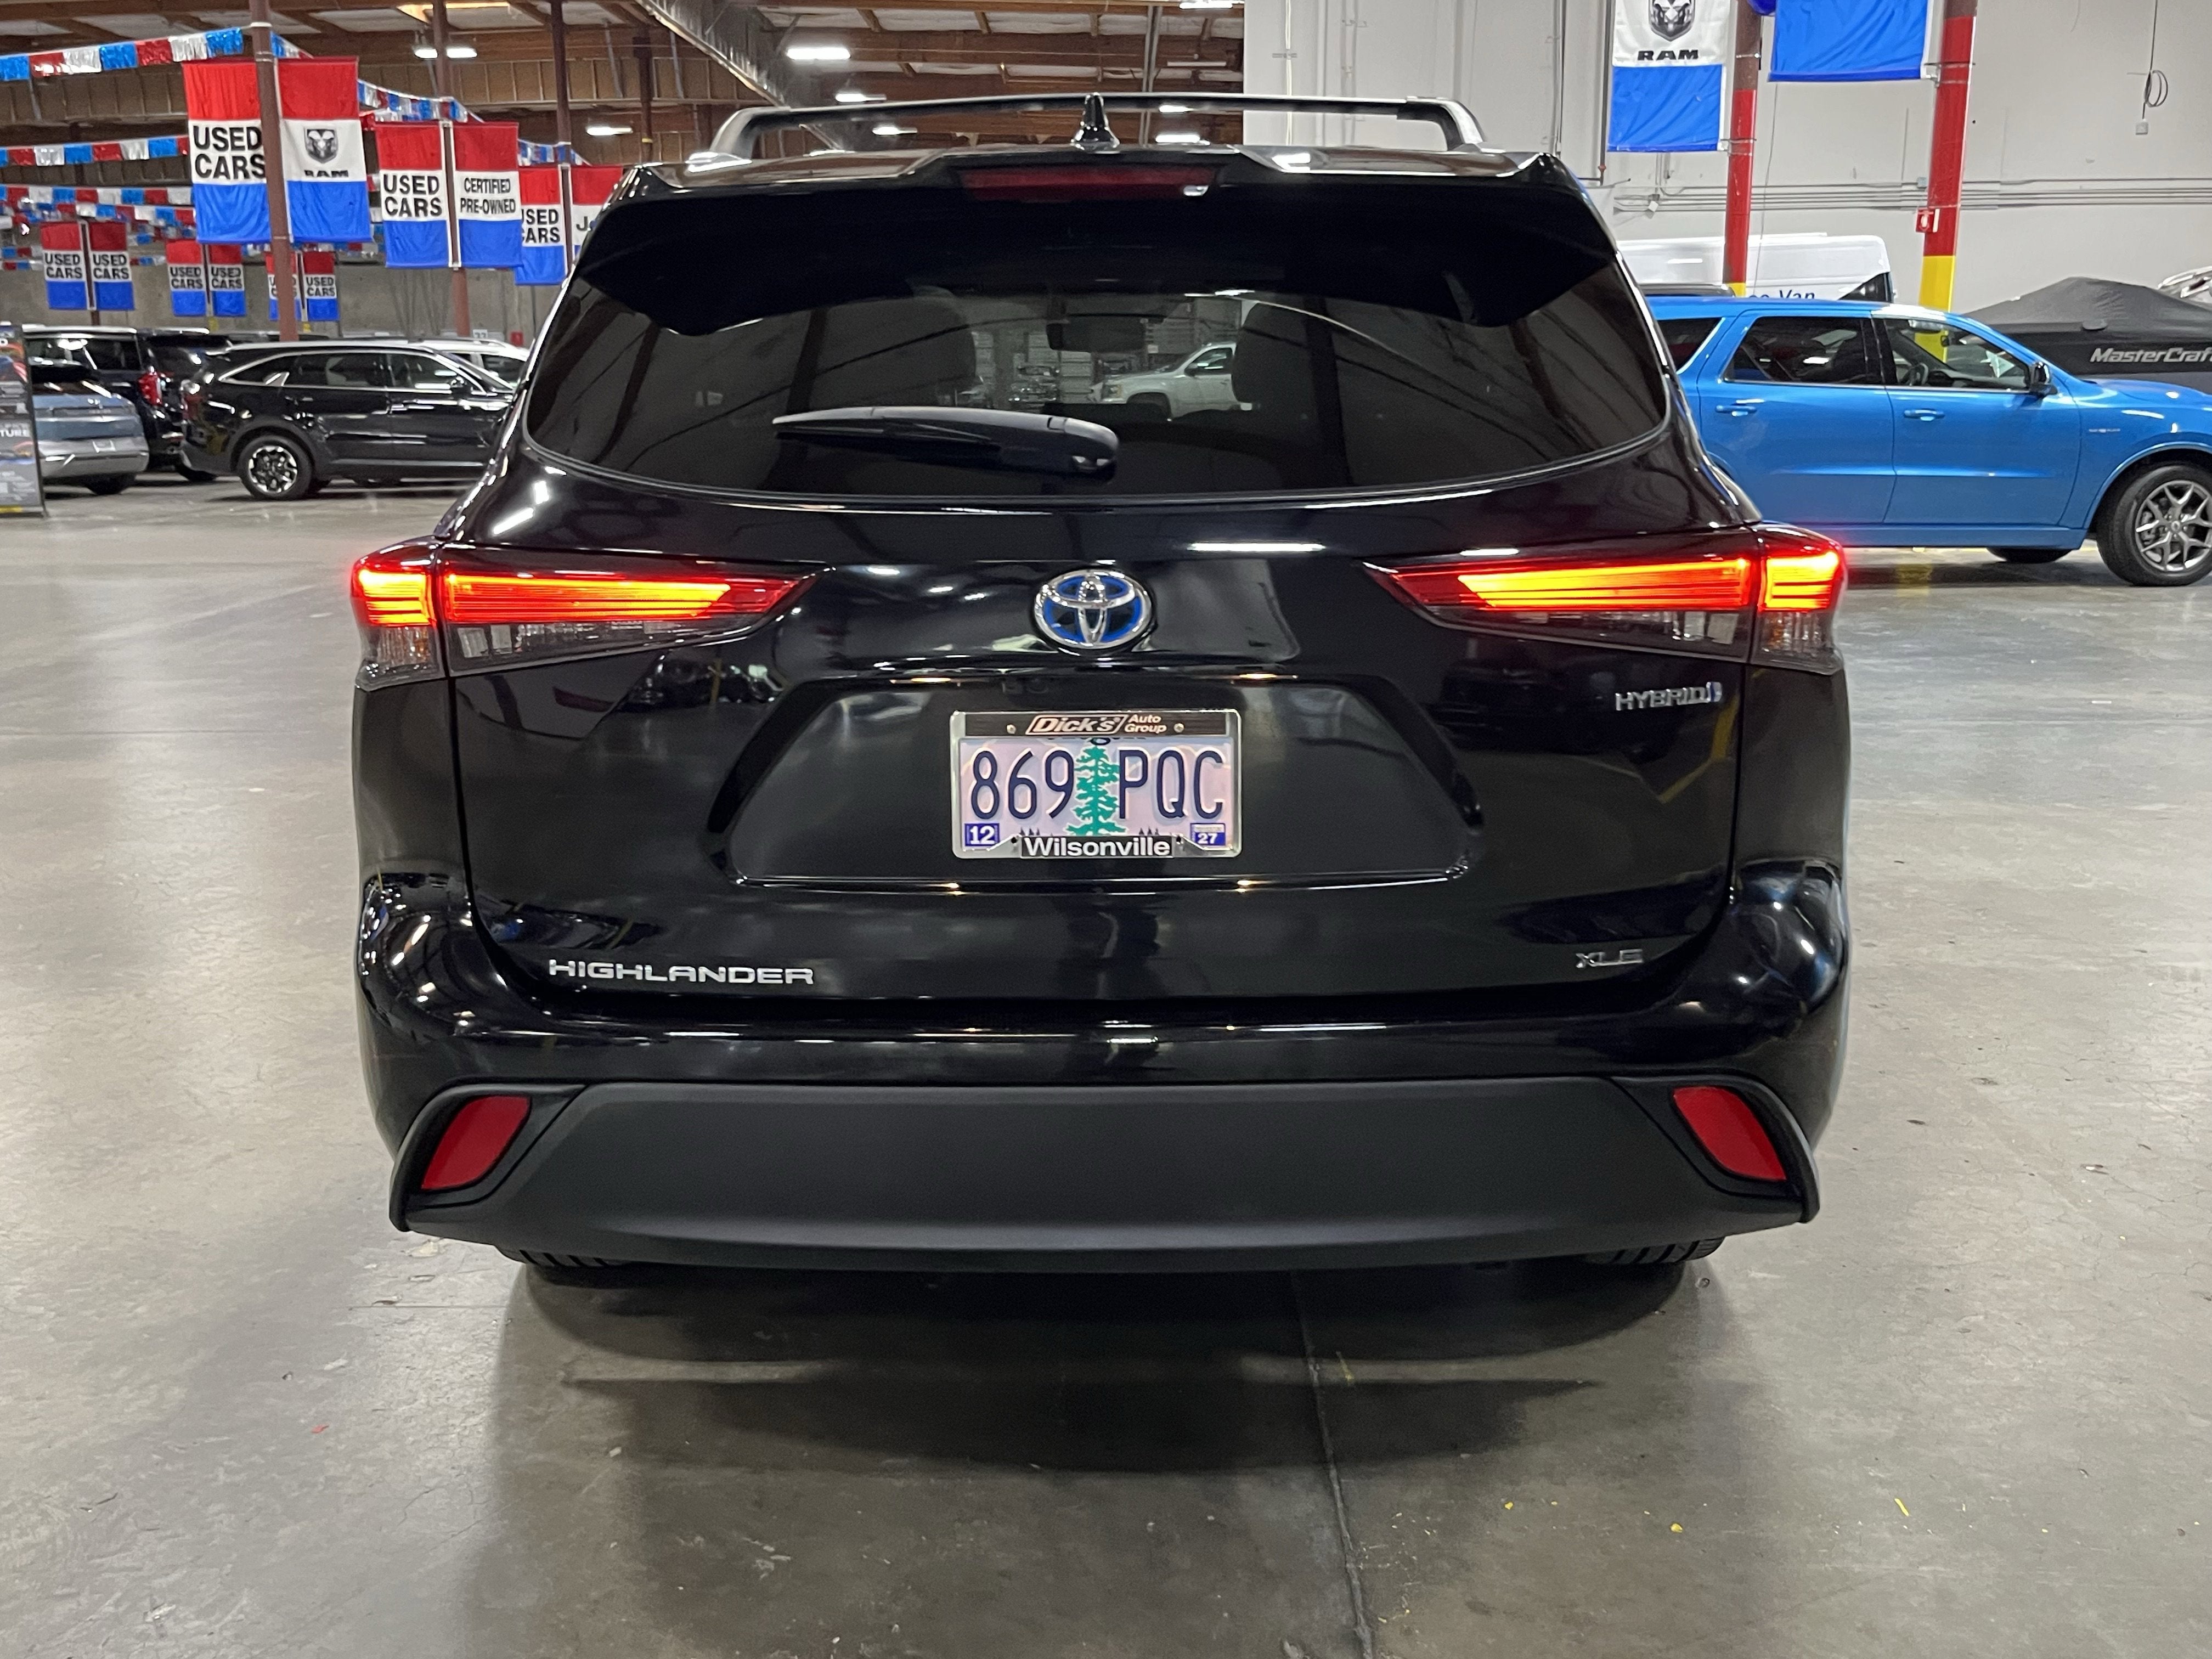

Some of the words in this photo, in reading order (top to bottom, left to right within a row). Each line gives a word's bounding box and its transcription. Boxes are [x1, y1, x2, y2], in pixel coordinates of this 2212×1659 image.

[1637, 49, 1699, 60] RAM
[193, 126, 262, 151] USED
[195, 154, 264, 179] CARS
[304, 170, 349, 178] RAM
[383, 174, 439, 195] USED
[464, 178, 511, 194] CERTIFIED
[385, 197, 442, 217] CARS
[460, 198, 516, 215] PRE-OWNED
[45, 253, 80, 265] USED
[93, 254, 127, 266] USED
[46, 267, 82, 278] CARS
[93, 268, 129, 279] CARS
[170, 267, 201, 276] USED
[211, 267, 241, 277] USED
[171, 278, 202, 289] CARS
[212, 278, 242, 289] CARS
[306, 277, 334, 286] USED
[307, 287, 335, 296] CARS
[2090, 347, 2212, 363] MasterCraf
[1615, 686, 1707, 711] HYBRID
[1032, 717, 1117, 732] Dick's
[1128, 714, 1161, 724] Auto
[1125, 724, 1167, 733] Group
[970, 749, 1074, 820] 869
[1118, 749, 1224, 820] PQC
[970, 825, 995, 845] 12
[1197, 832, 1218, 844] 27
[1024, 837, 1171, 857] Wilsonville
[549, 960, 814, 985] HIGHLANDER
